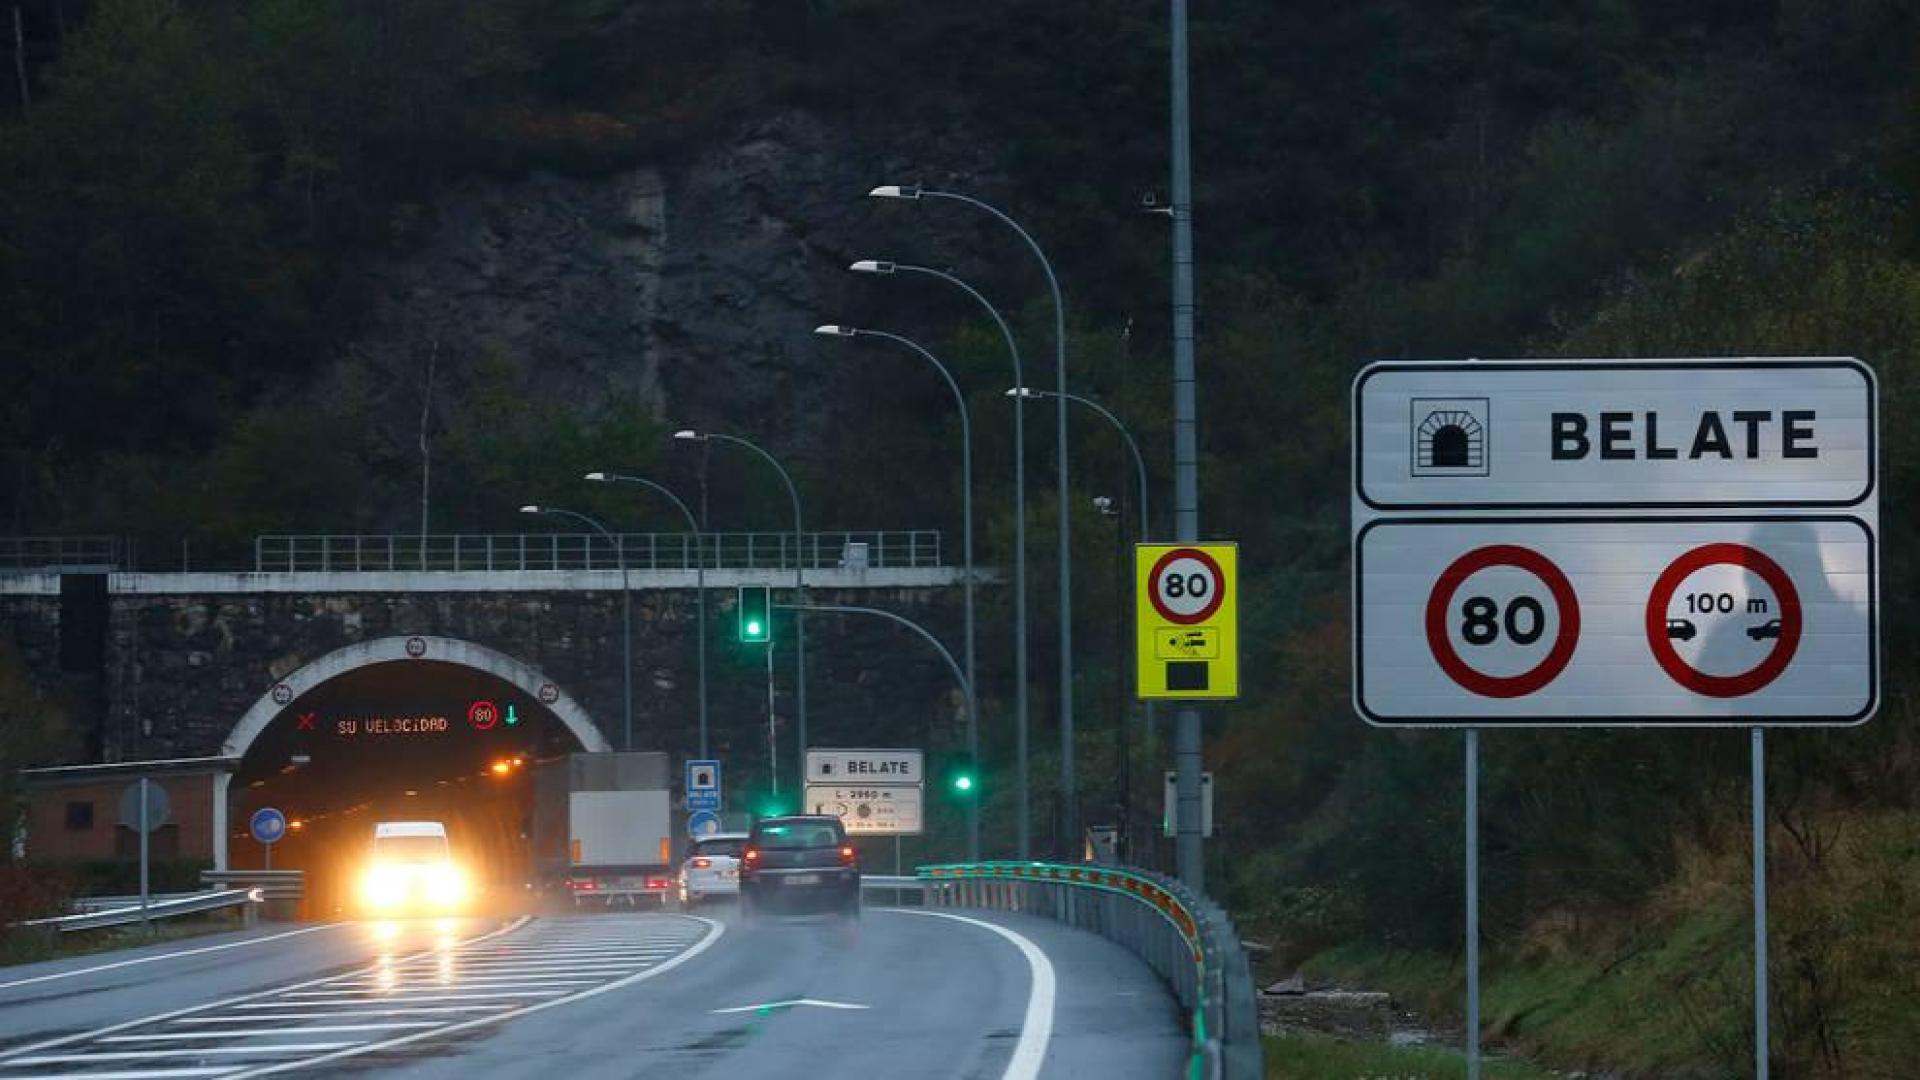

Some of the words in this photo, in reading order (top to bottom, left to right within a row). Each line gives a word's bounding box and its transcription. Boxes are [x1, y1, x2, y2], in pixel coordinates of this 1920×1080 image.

[1552, 411, 1818, 460] BELATE
[1165, 573, 1207, 598] 80
[1686, 593, 1734, 613] 100
[1747, 594, 1767, 613] m
[1461, 596, 1545, 646] 80
[474, 707, 492, 722] 80
[337, 720, 357, 734] SU
[847, 761, 909, 774] BELATE
